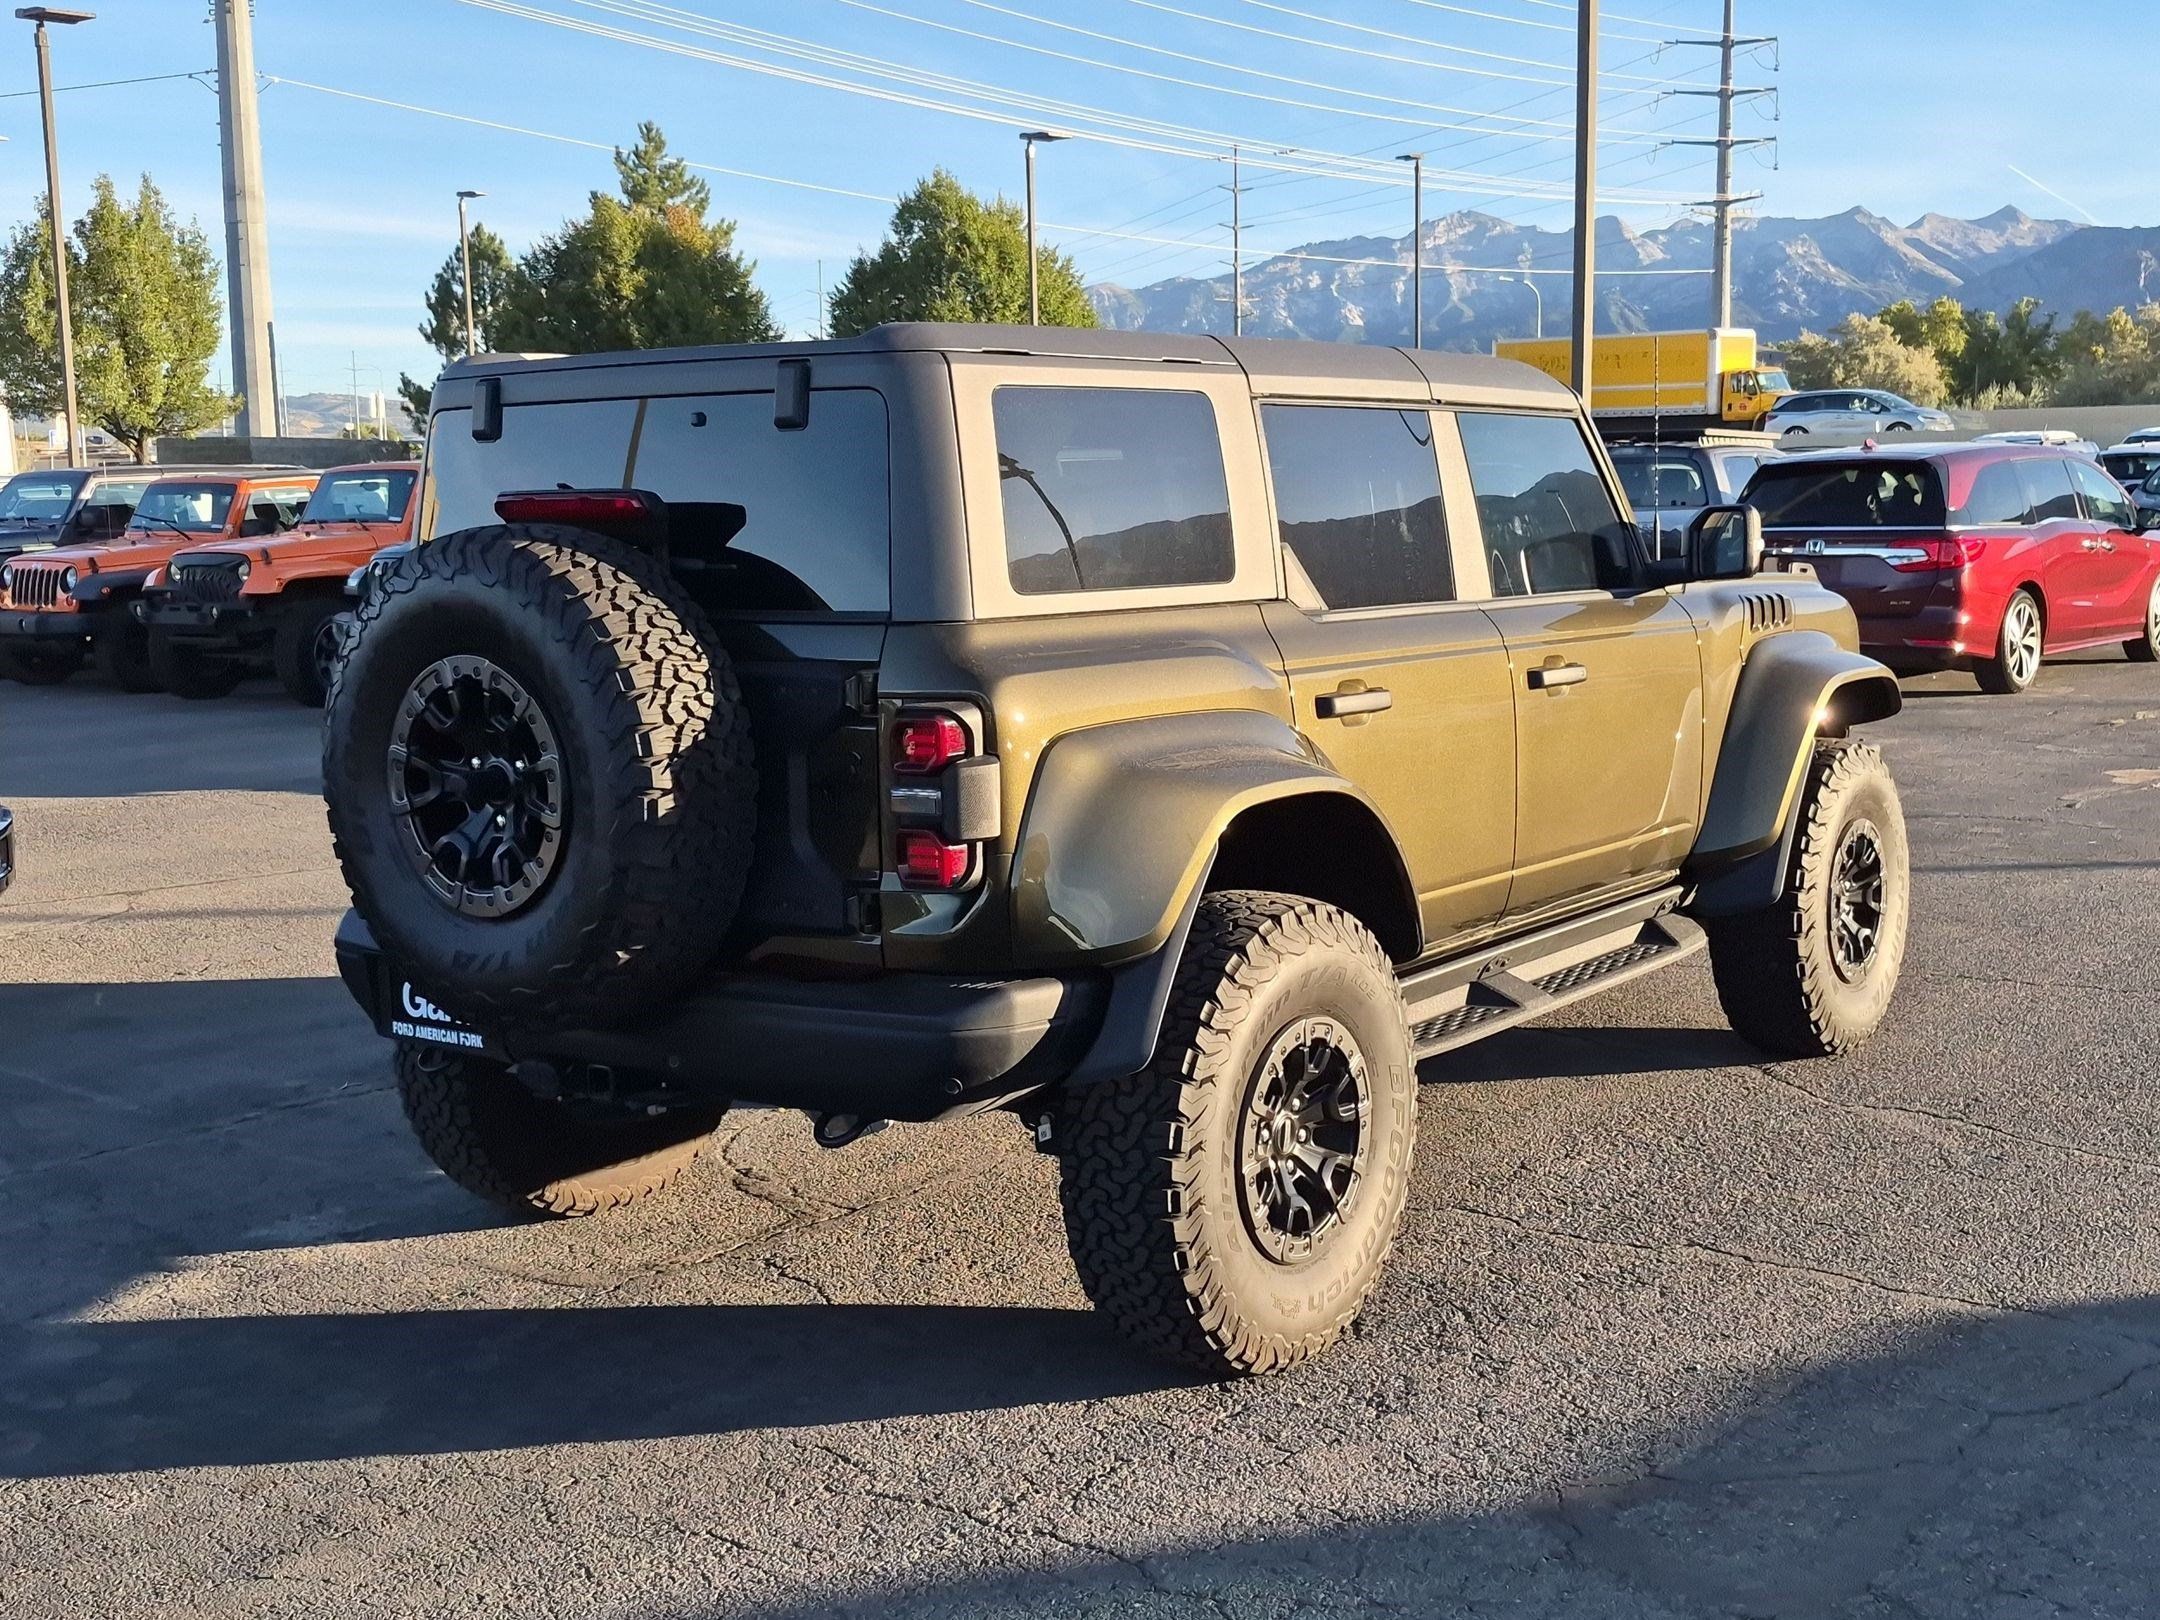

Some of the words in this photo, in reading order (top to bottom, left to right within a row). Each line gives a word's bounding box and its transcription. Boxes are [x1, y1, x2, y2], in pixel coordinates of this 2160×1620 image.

[1300, 965, 1348, 993] T/A
[392, 1020, 414, 1037] FORD
[415, 1024, 458, 1045] AMERICAN
[459, 1032, 484, 1049] FORK
[1308, 1063, 1407, 1314] BFGoodrich
